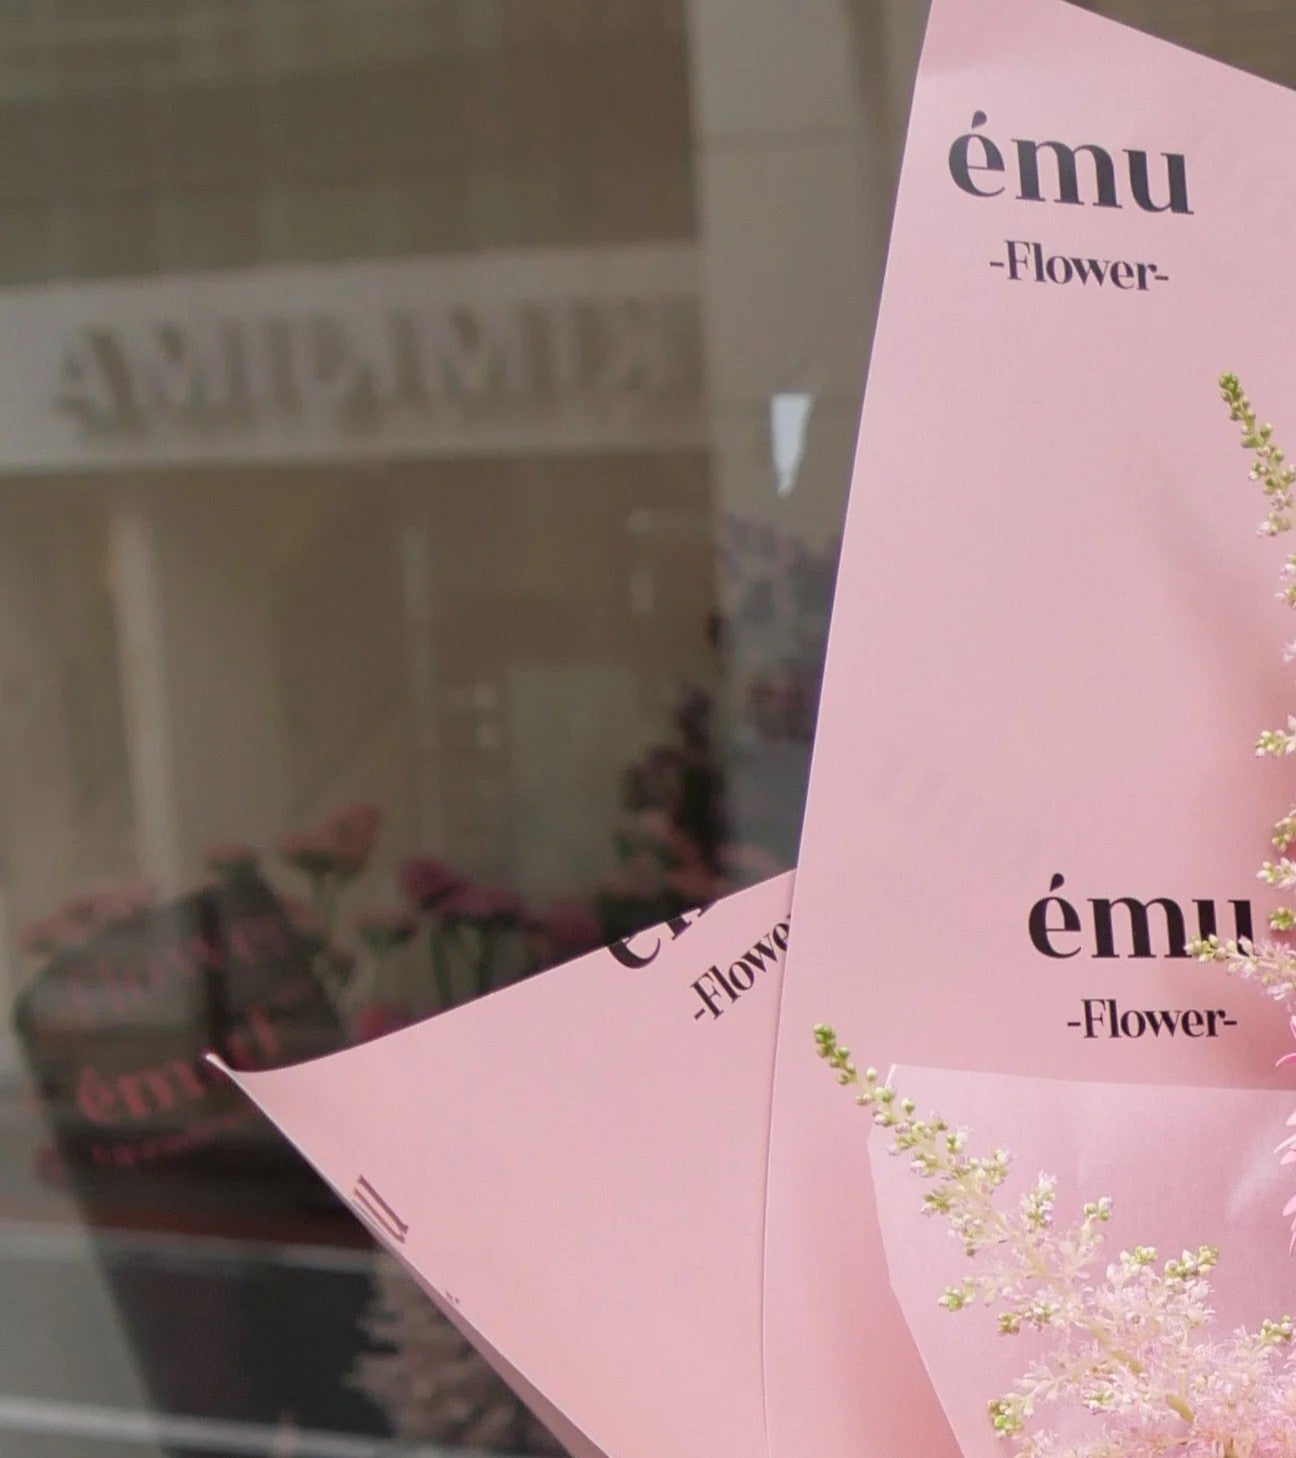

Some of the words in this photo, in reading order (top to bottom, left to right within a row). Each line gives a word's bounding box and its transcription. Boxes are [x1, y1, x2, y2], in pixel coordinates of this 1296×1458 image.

[948, 109, 1194, 215] ému
[989, 239, 1169, 291] -Flower-
[1028, 873, 1260, 959] ému
[690, 912, 791, 1020] -Flowe
[1067, 998, 1237, 1038] -Flower-
